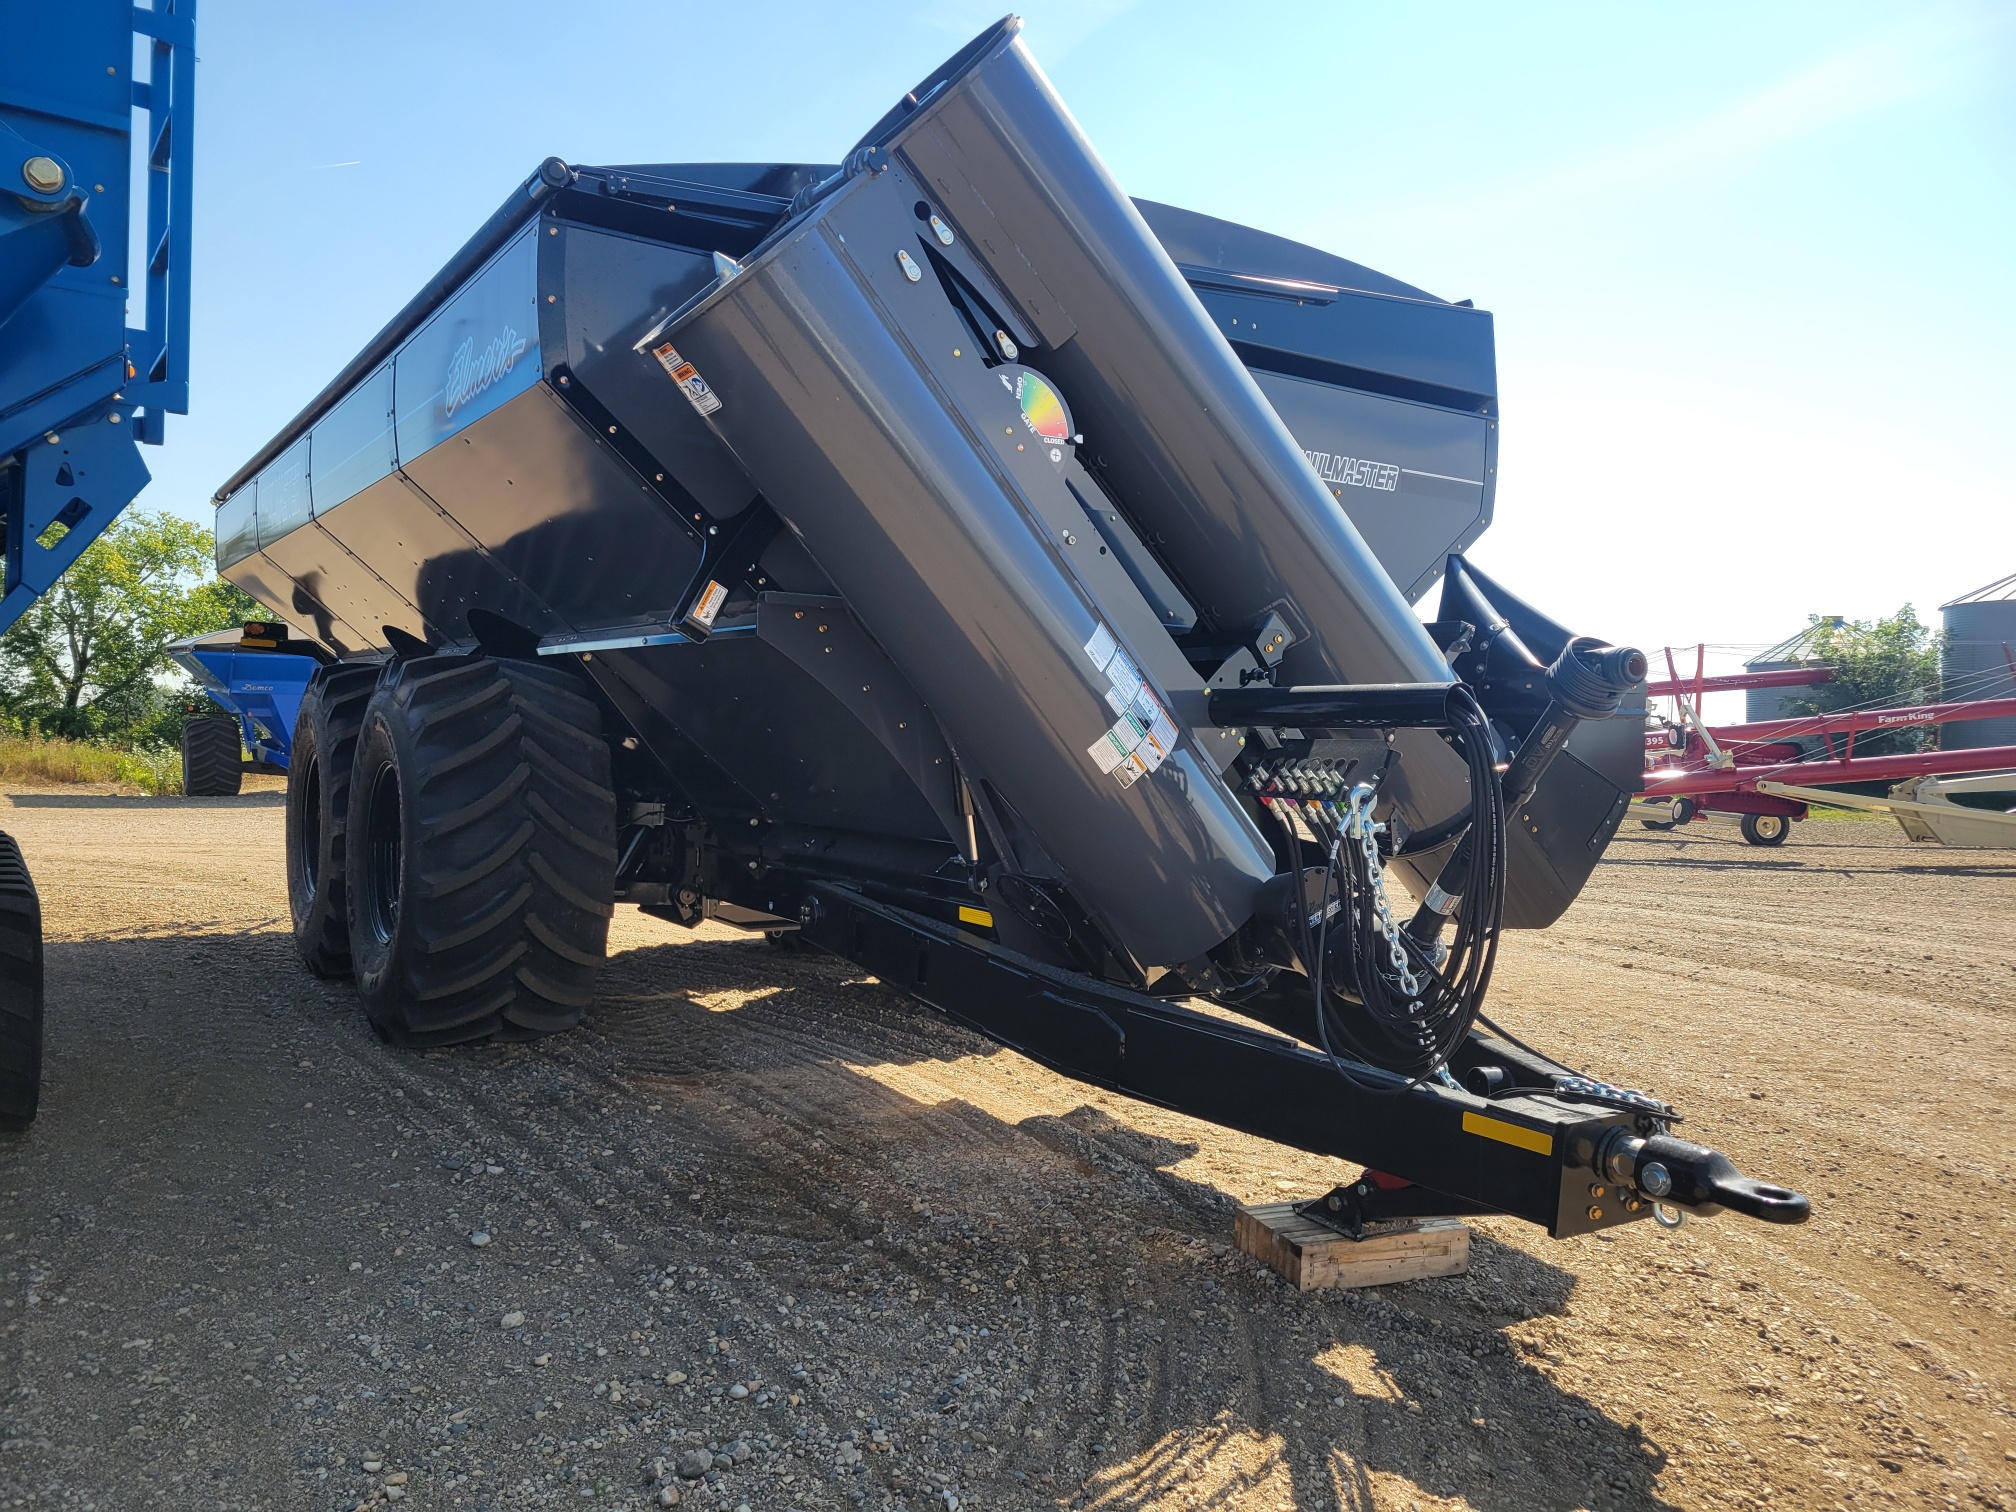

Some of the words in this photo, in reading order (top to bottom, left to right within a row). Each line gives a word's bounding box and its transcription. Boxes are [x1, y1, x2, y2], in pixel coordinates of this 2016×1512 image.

[1021, 413, 1036, 433] GATE
[1043, 437, 1065, 445] CLOSED
[1302, 450, 1399, 491] ULMASTER
[1127, 713, 1143, 736] IMPORTANT
[1109, 732, 1126, 755] IMPORTANT
[1645, 736, 1664, 746] 395
